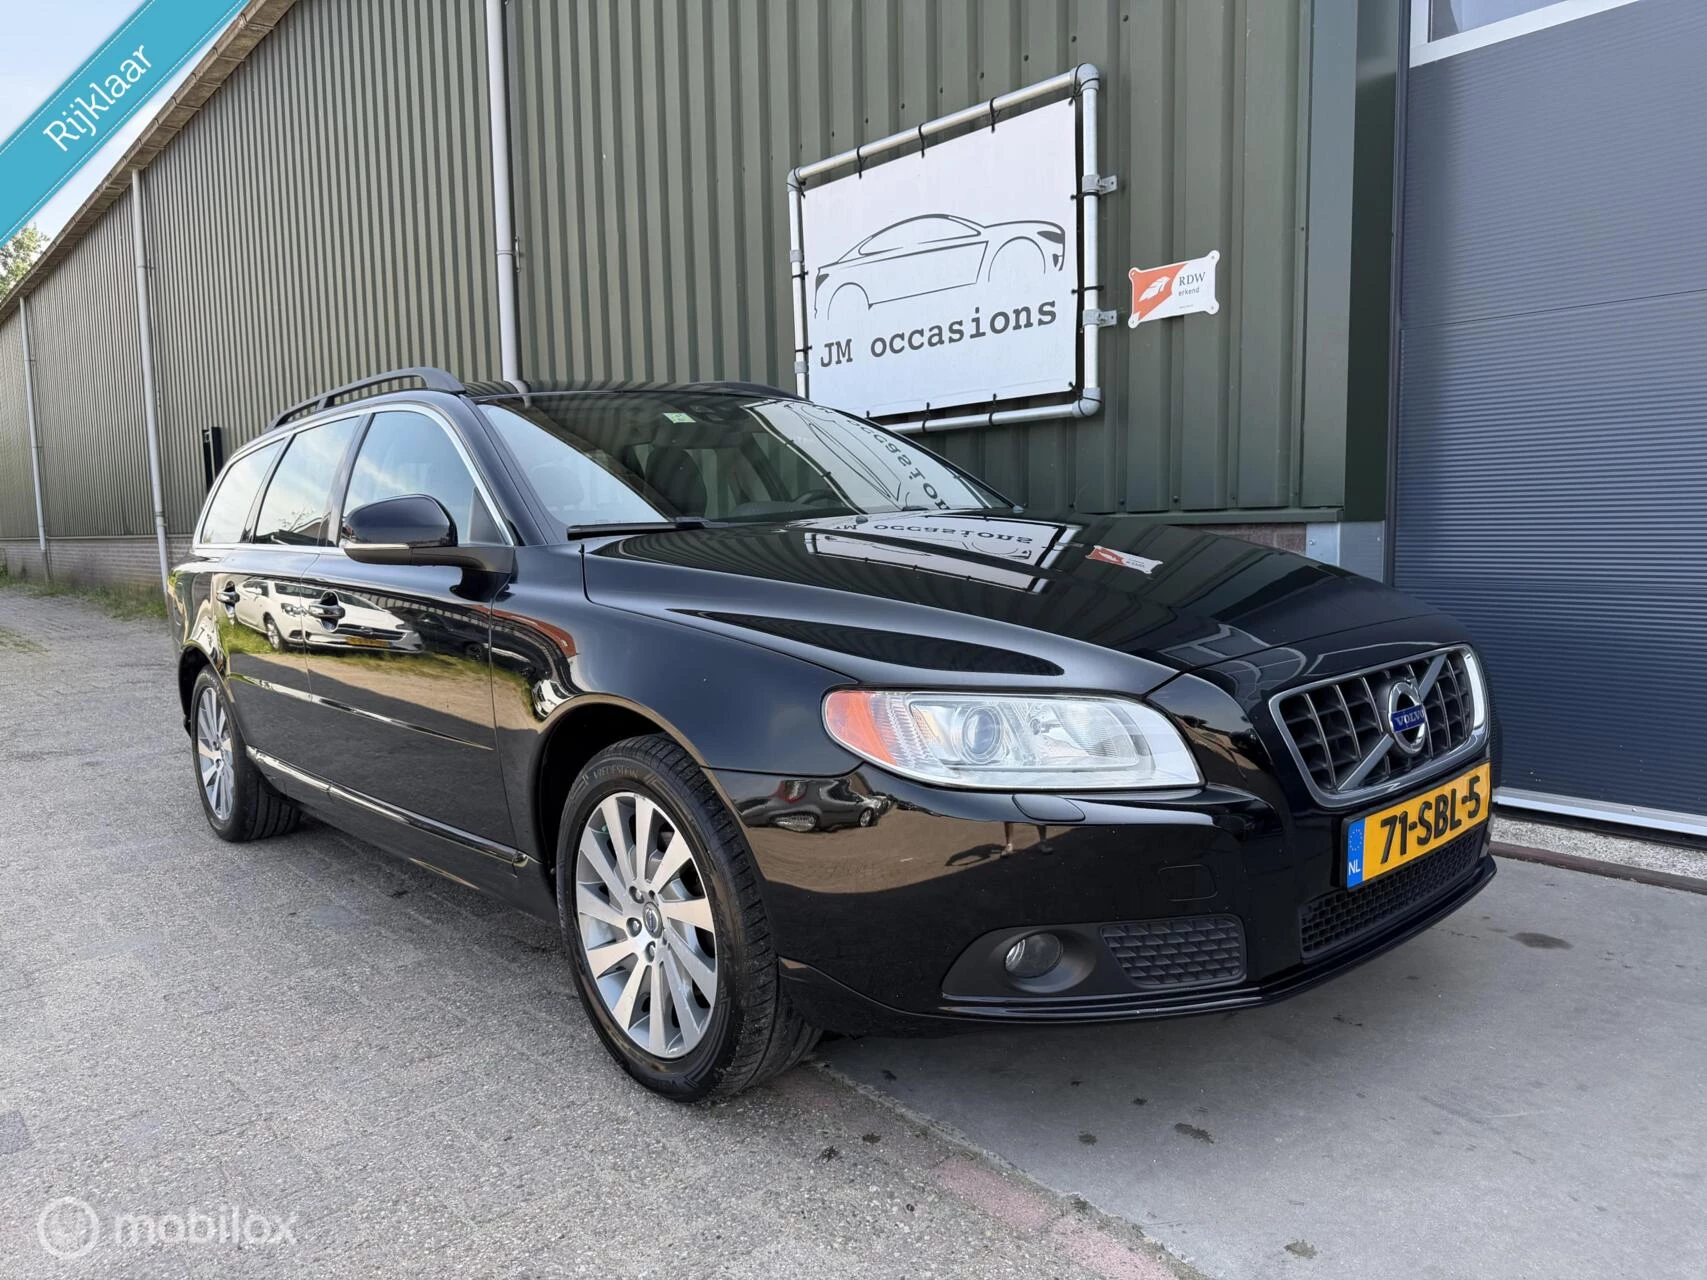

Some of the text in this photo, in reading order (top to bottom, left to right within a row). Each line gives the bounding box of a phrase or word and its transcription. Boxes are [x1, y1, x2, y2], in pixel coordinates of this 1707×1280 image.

[1178, 271, 1206, 286] RDW
[1178, 287, 1200, 297] erkend
[820, 300, 1057, 368] JM occasions
[1394, 709, 1426, 727] VOLVO
[1380, 775, 1482, 865] 71-SBL-5
[1348, 859, 1361, 876] NL
